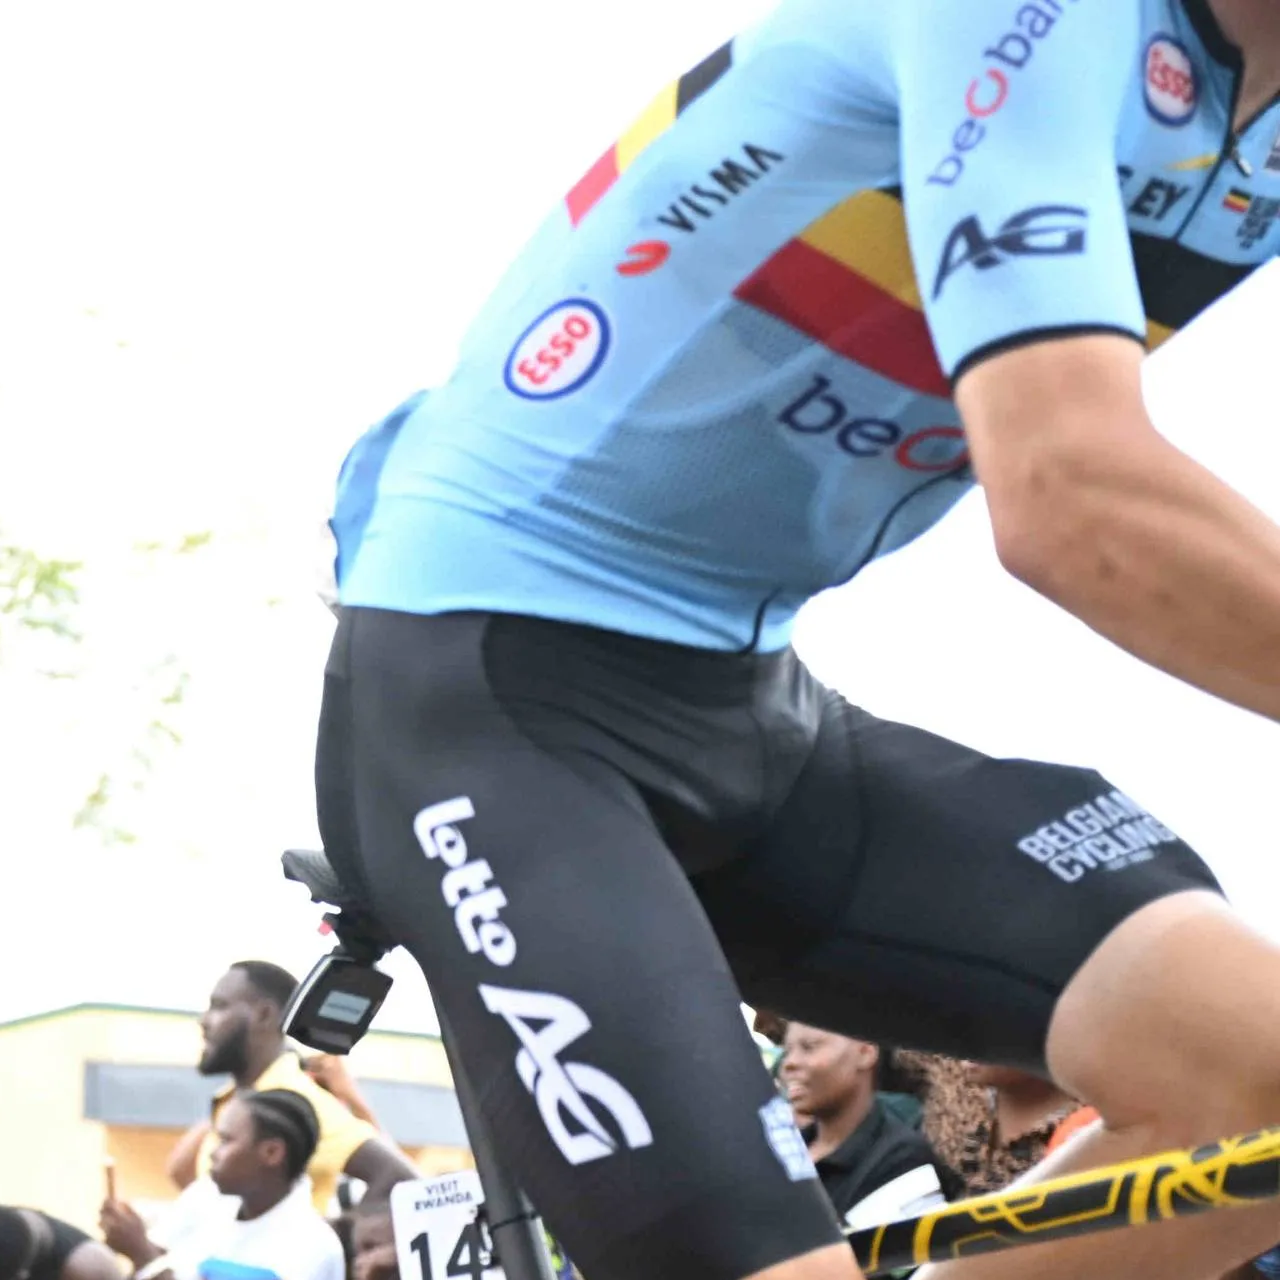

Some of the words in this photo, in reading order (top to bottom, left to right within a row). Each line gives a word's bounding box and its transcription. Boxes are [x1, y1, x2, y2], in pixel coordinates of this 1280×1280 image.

[657, 143, 784, 232] VISMA
[1130, 177, 1191, 220] EY
[932, 205, 1088, 302] AG
[517, 315, 590, 384] Esso
[1018, 790, 1143, 864] BELGIAN
[1047, 815, 1178, 883] CYCLING
[478, 983, 653, 1166] AG
[424, 1179, 459, 1196] VISIT
